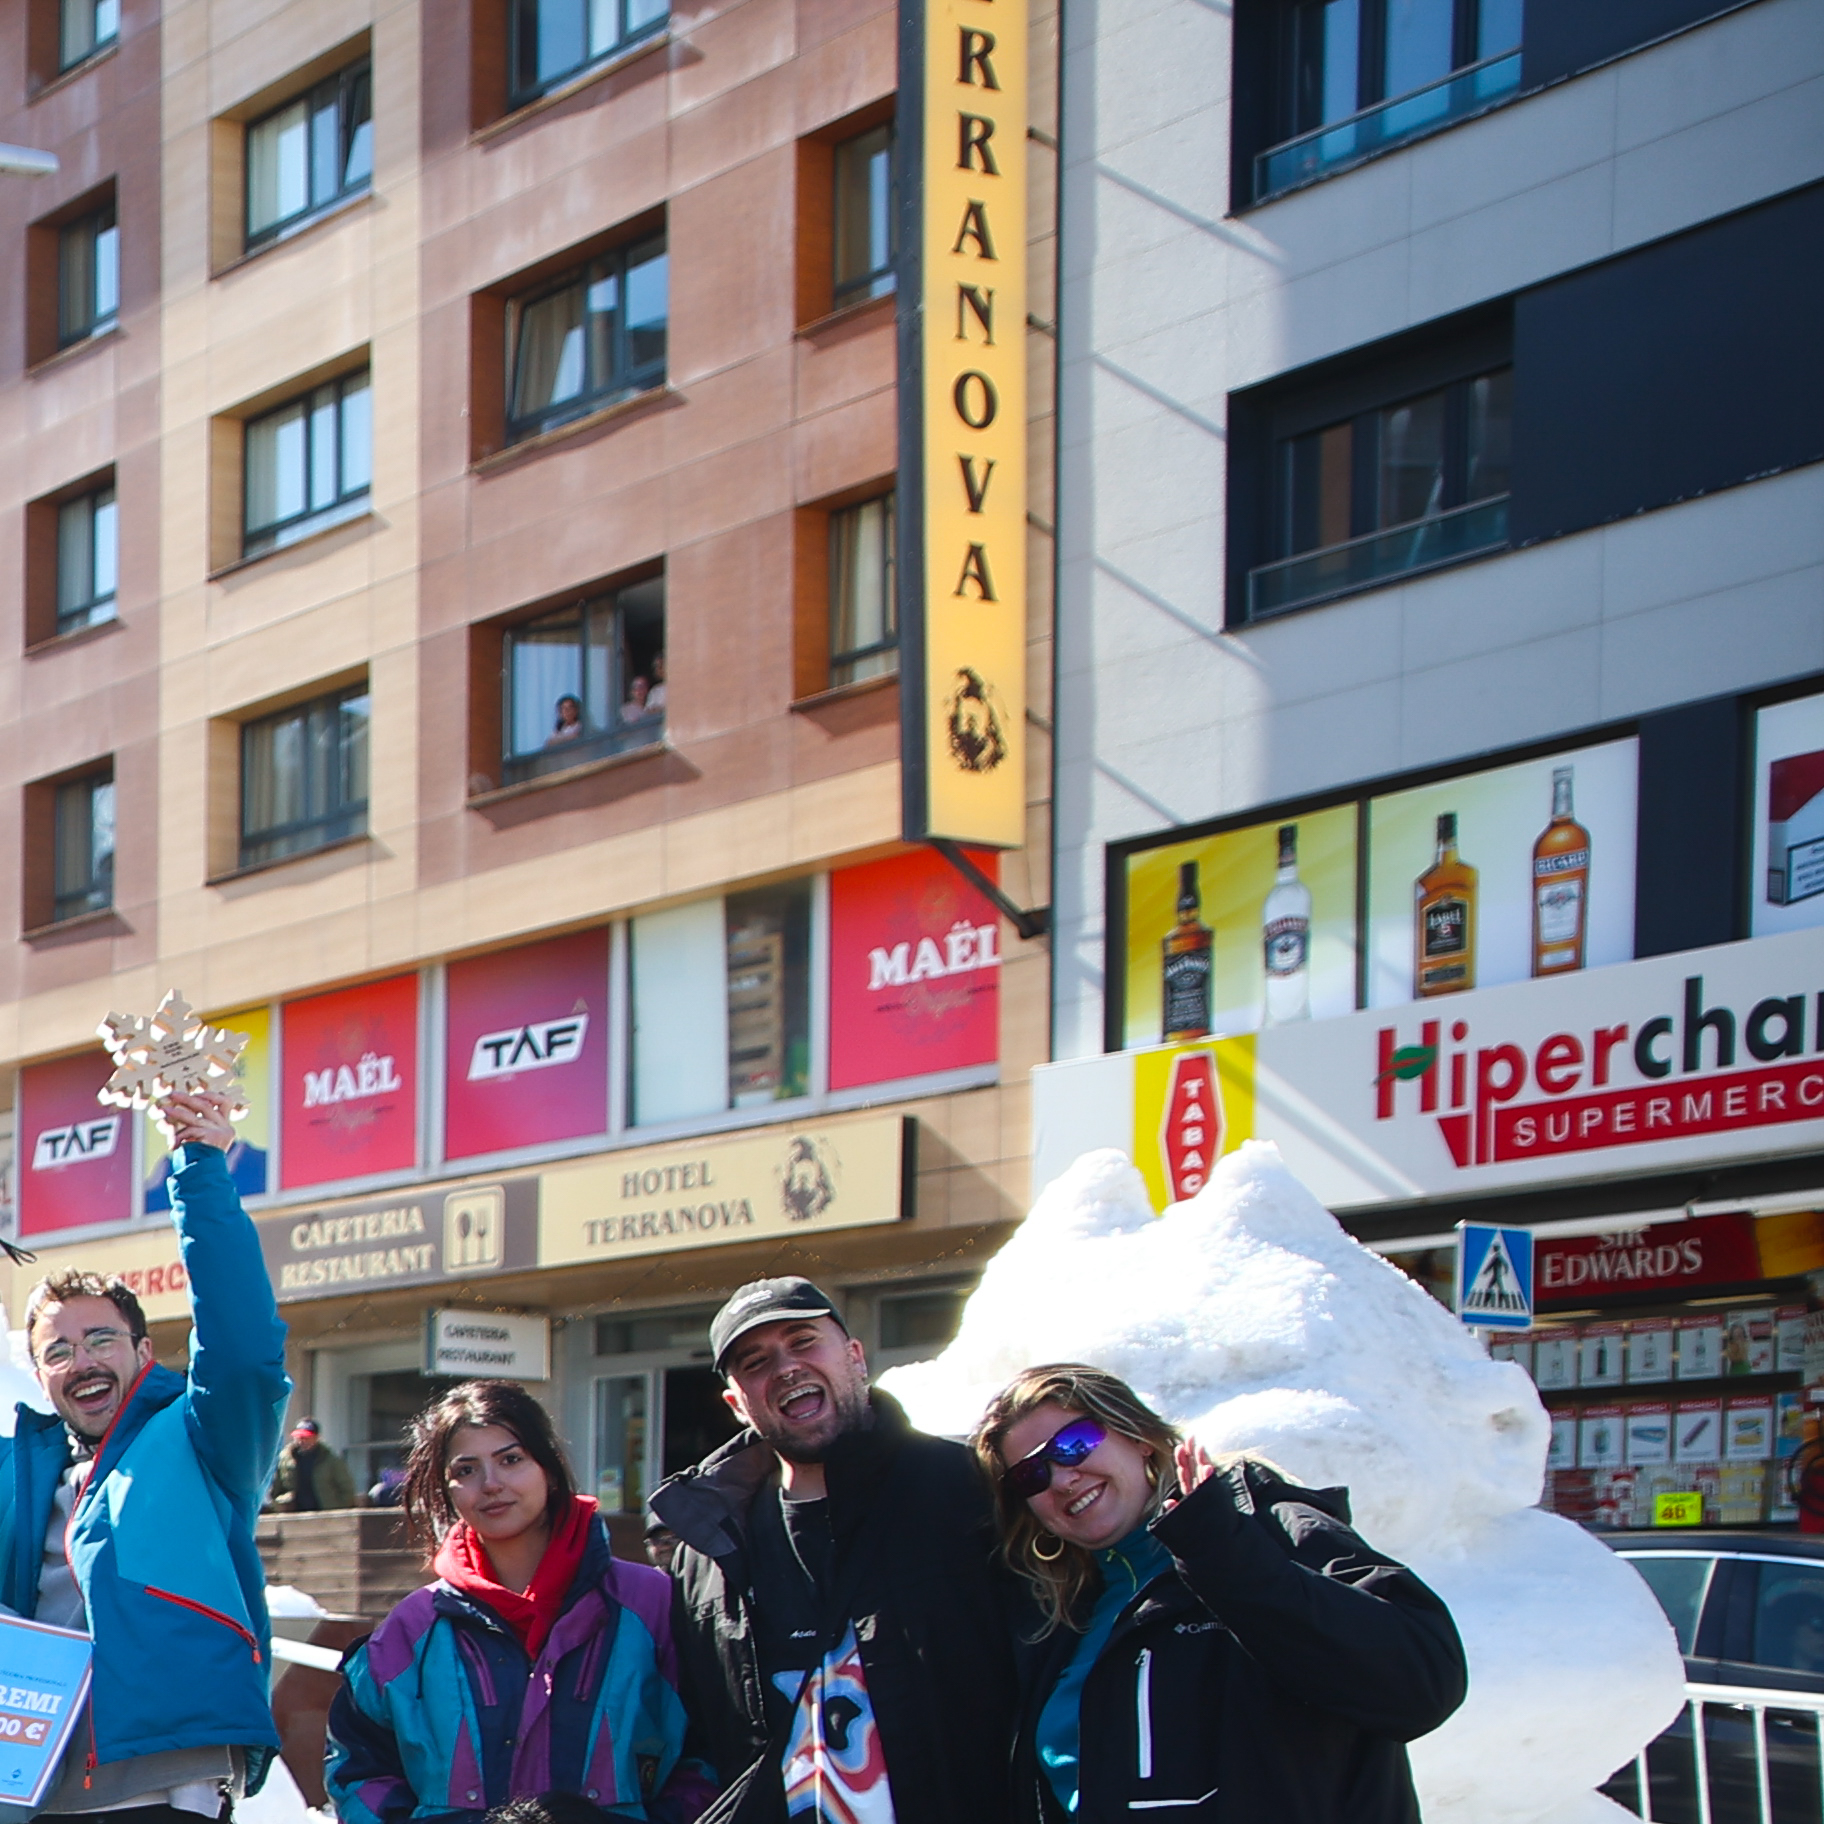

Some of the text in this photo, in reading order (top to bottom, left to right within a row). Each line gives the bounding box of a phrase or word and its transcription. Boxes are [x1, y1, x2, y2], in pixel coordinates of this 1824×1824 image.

[952, 0, 1001, 602] RRANOVA
[867, 919, 1002, 991] MAËL
[482, 1023, 579, 1068] TAF
[303, 1052, 400, 1108] MAËL
[42, 1124, 113, 1160] TAF
[1180, 1077, 1206, 1196] TABAC
[620, 1159, 714, 1200] HOTEL
[290, 1205, 425, 1251] CAFETERIA
[583, 1198, 755, 1245] TERRANOVA
[280, 1243, 436, 1289] RESTAURANT
[1543, 1239, 1703, 1289] EDWARD'S
[24, 1721, 46, 1741] €
